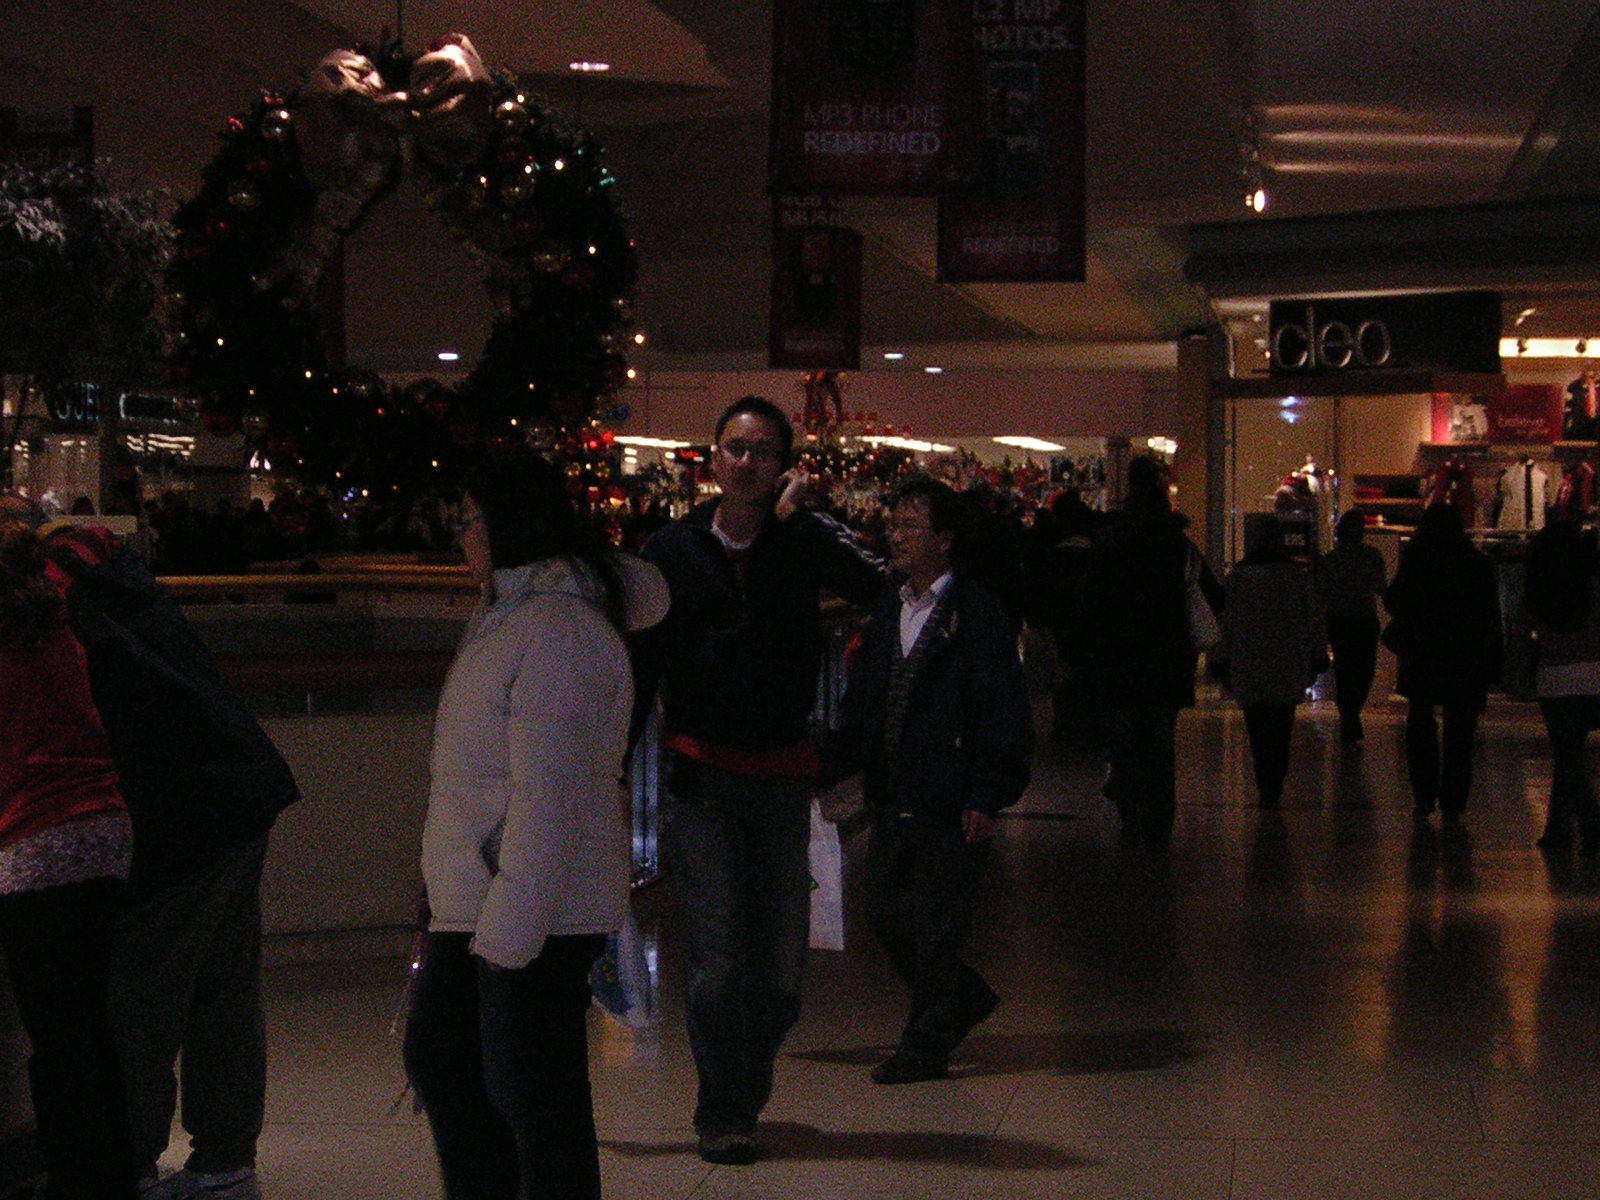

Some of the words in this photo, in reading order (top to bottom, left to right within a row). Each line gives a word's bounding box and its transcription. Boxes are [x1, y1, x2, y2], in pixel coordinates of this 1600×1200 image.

[803, 103, 853, 126] MP3
[862, 103, 944, 128] PHONE
[804, 131, 942, 154] REDEFINED
[1275, 303, 1392, 369] cleo
